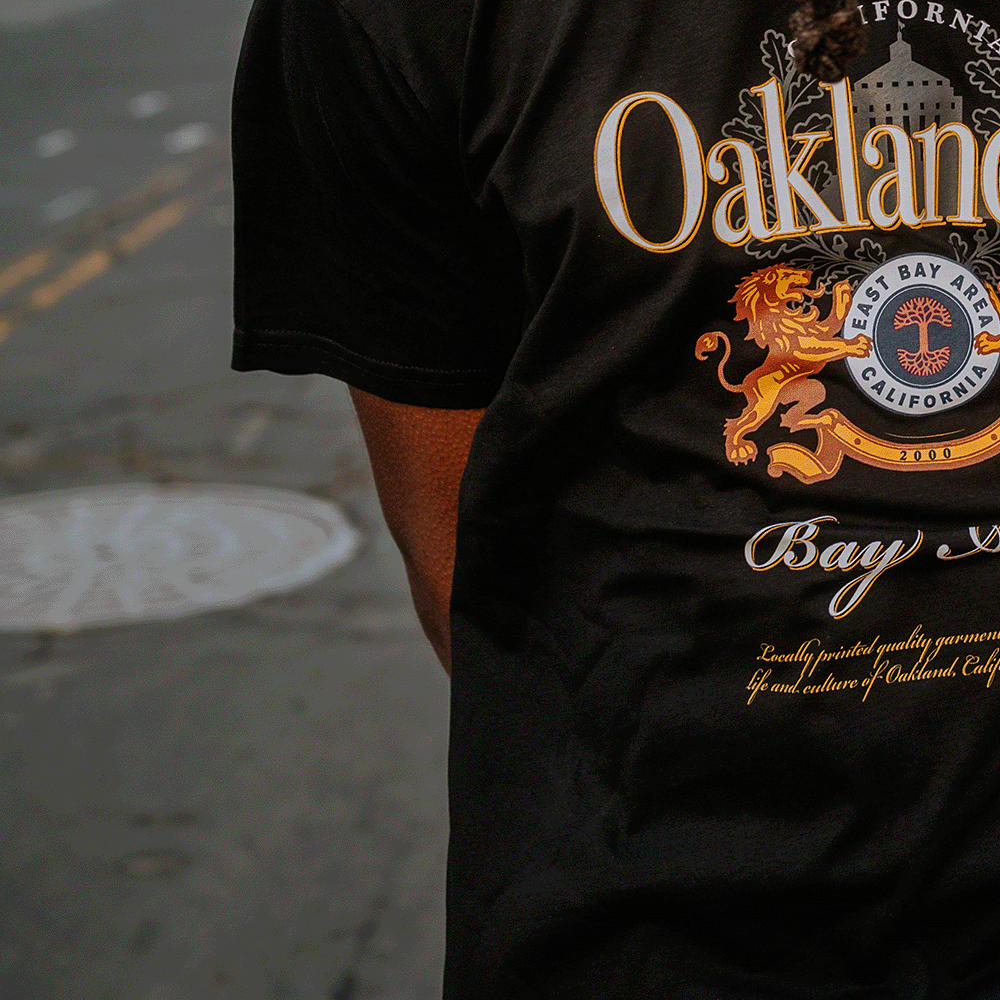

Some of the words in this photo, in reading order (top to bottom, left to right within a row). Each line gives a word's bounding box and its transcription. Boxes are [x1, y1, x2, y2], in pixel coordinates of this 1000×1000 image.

[852, 275, 889, 331] EAST
[898, 262, 941, 281] BAY
[950, 274, 994, 329] AREA
[861, 365, 988, 409] CALIFORNIA
[900, 447, 952, 462] 2000
[744, 515, 924, 619] Bay
[756, 638, 821, 677] Locally
[808, 635, 880, 677] printed
[873, 623, 933, 669] quality
[746, 668, 772, 705] life
[770, 674, 803, 694] and
[803, 672, 858, 695] culture
[861, 659, 890, 703] of
[885, 656, 960, 684] Oakland,
